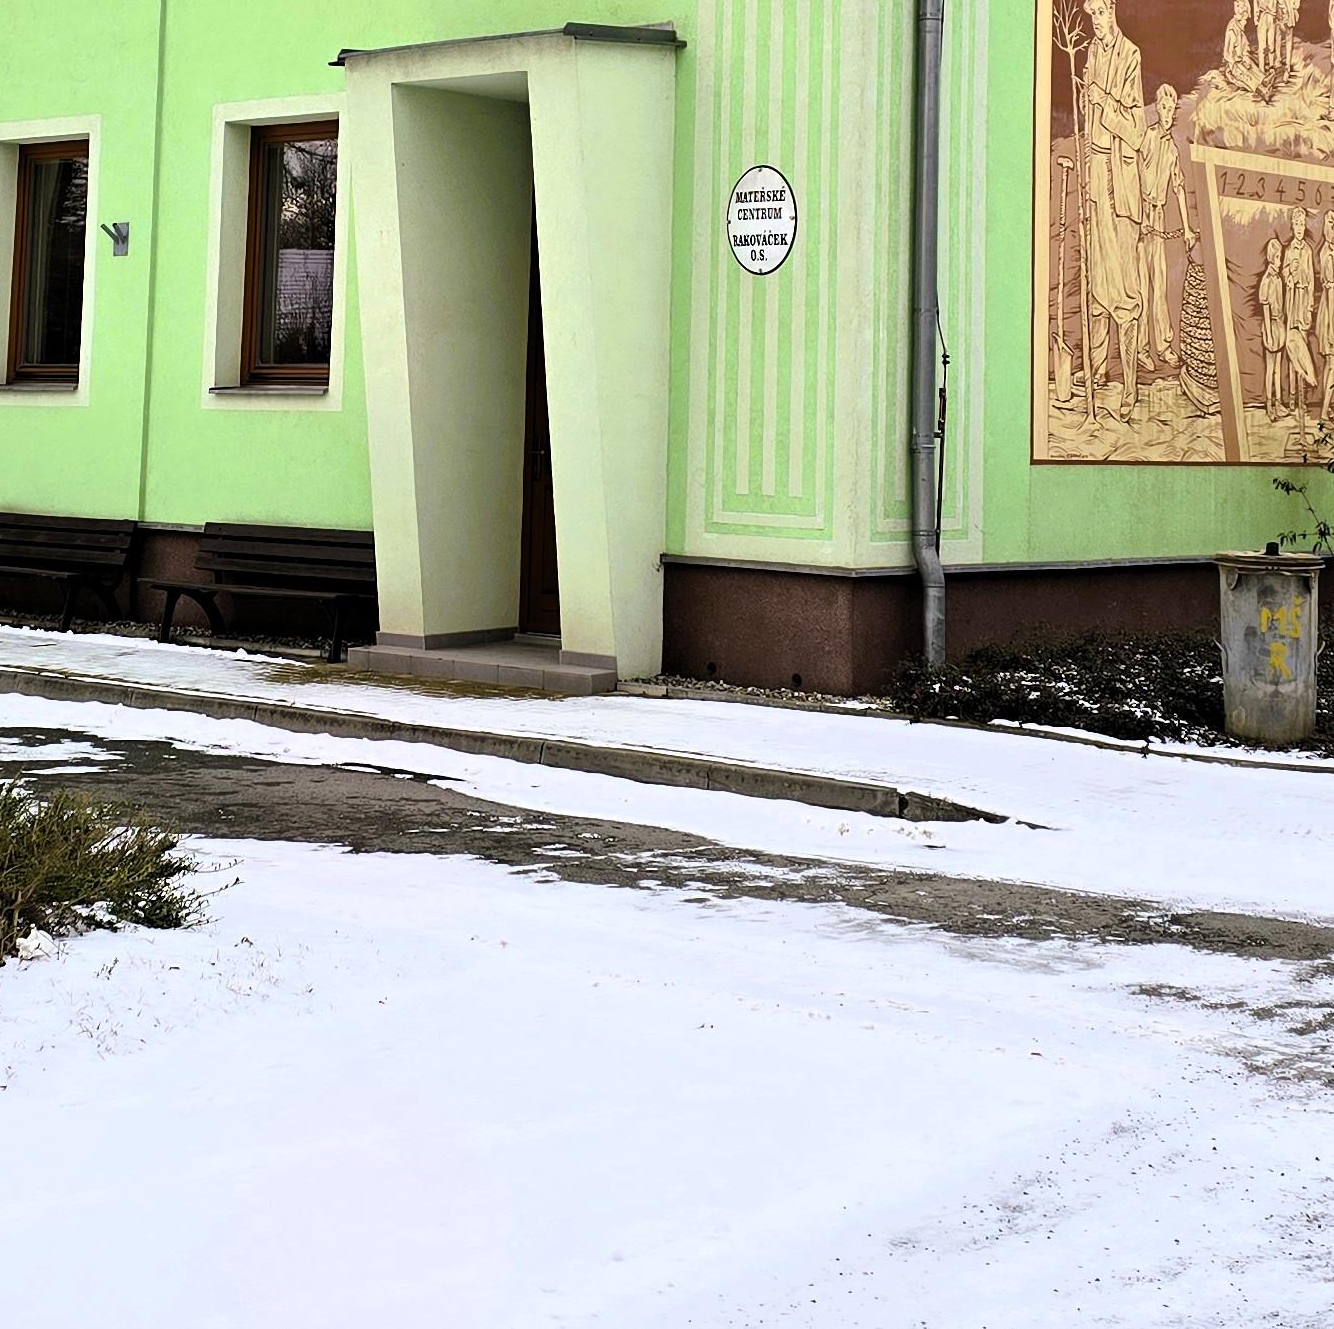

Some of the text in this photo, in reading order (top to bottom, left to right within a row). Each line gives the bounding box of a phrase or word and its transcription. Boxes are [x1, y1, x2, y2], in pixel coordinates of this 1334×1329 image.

[735, 186, 786, 203] MATEŘSKÉ
[737, 207, 783, 220] CENTRUM
[732, 230, 788, 247] RAKOVÁČEK
[750, 249, 768, 262] O.S.
